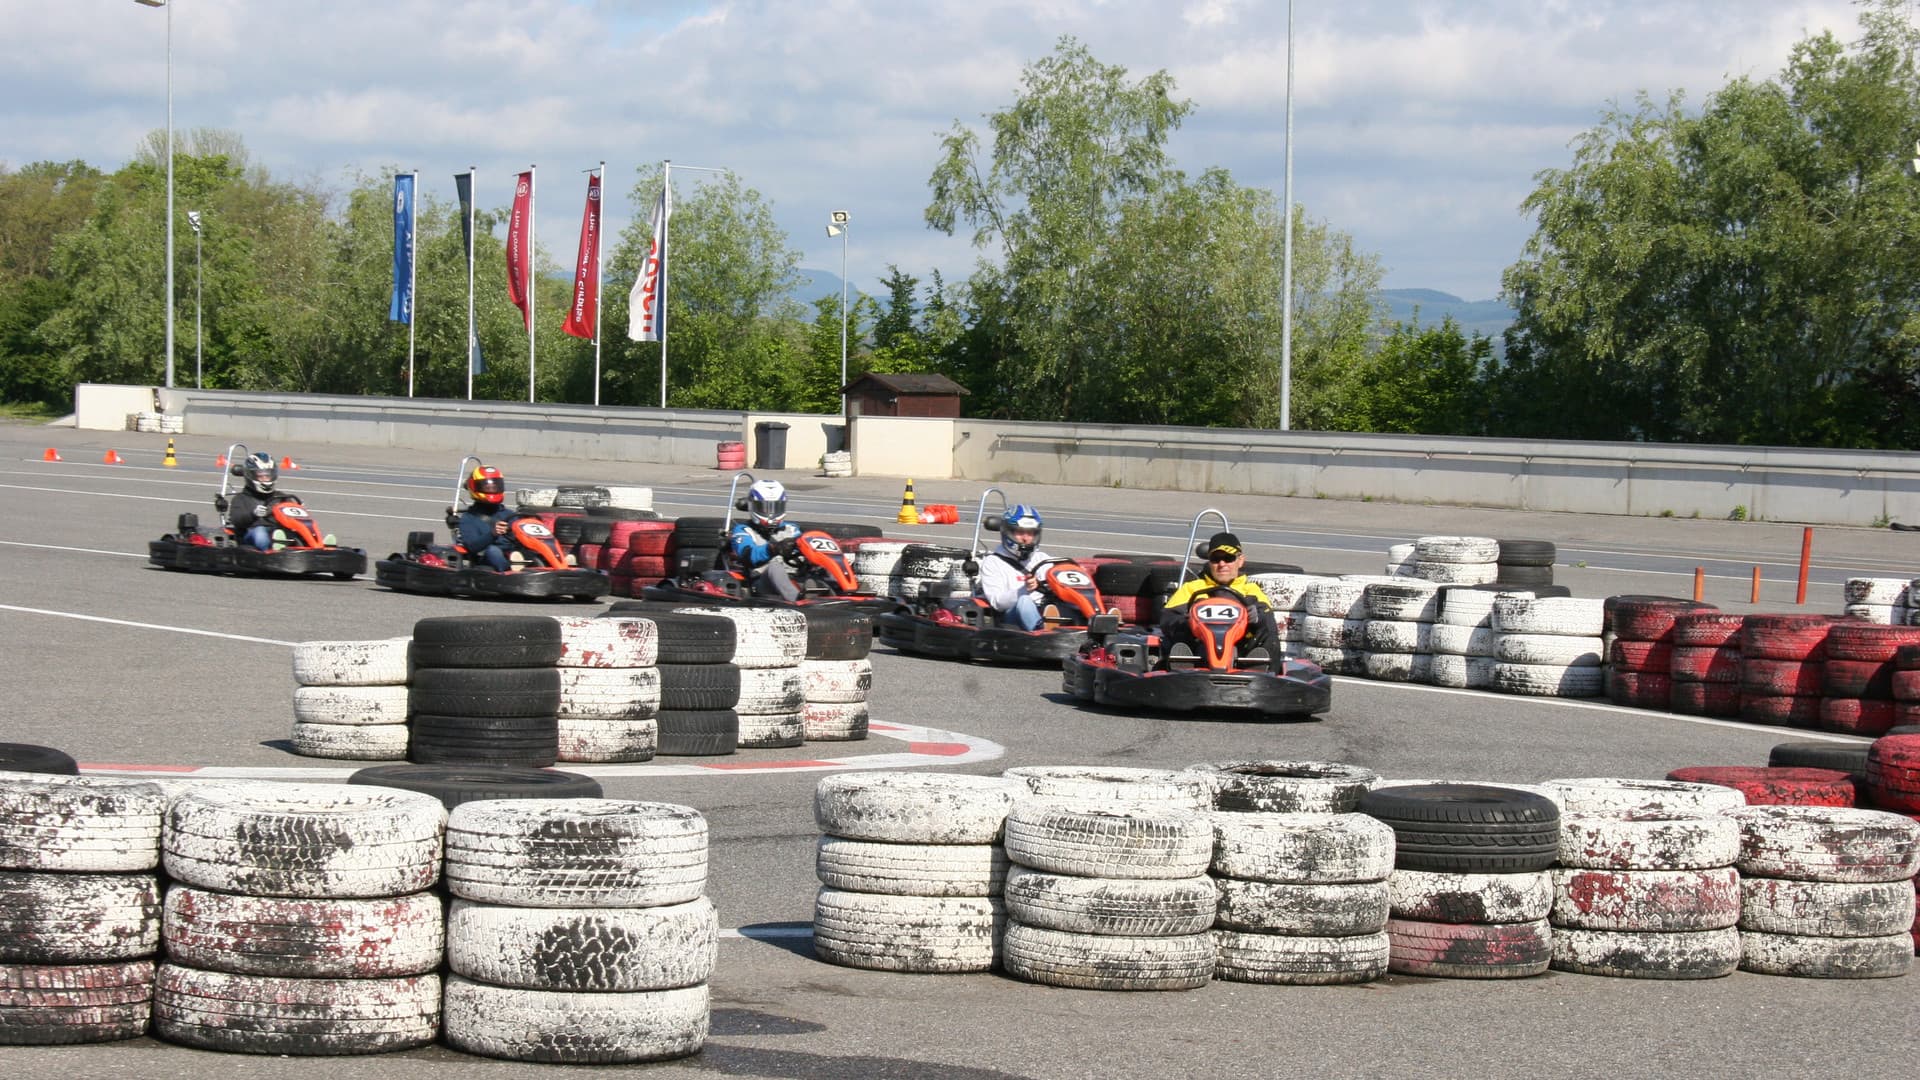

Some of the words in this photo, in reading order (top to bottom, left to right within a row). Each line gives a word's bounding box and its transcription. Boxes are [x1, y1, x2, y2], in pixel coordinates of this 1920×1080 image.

[812, 540, 838, 551] 20
[1066, 573, 1081, 584] 5
[1200, 607, 1235, 618] 14
